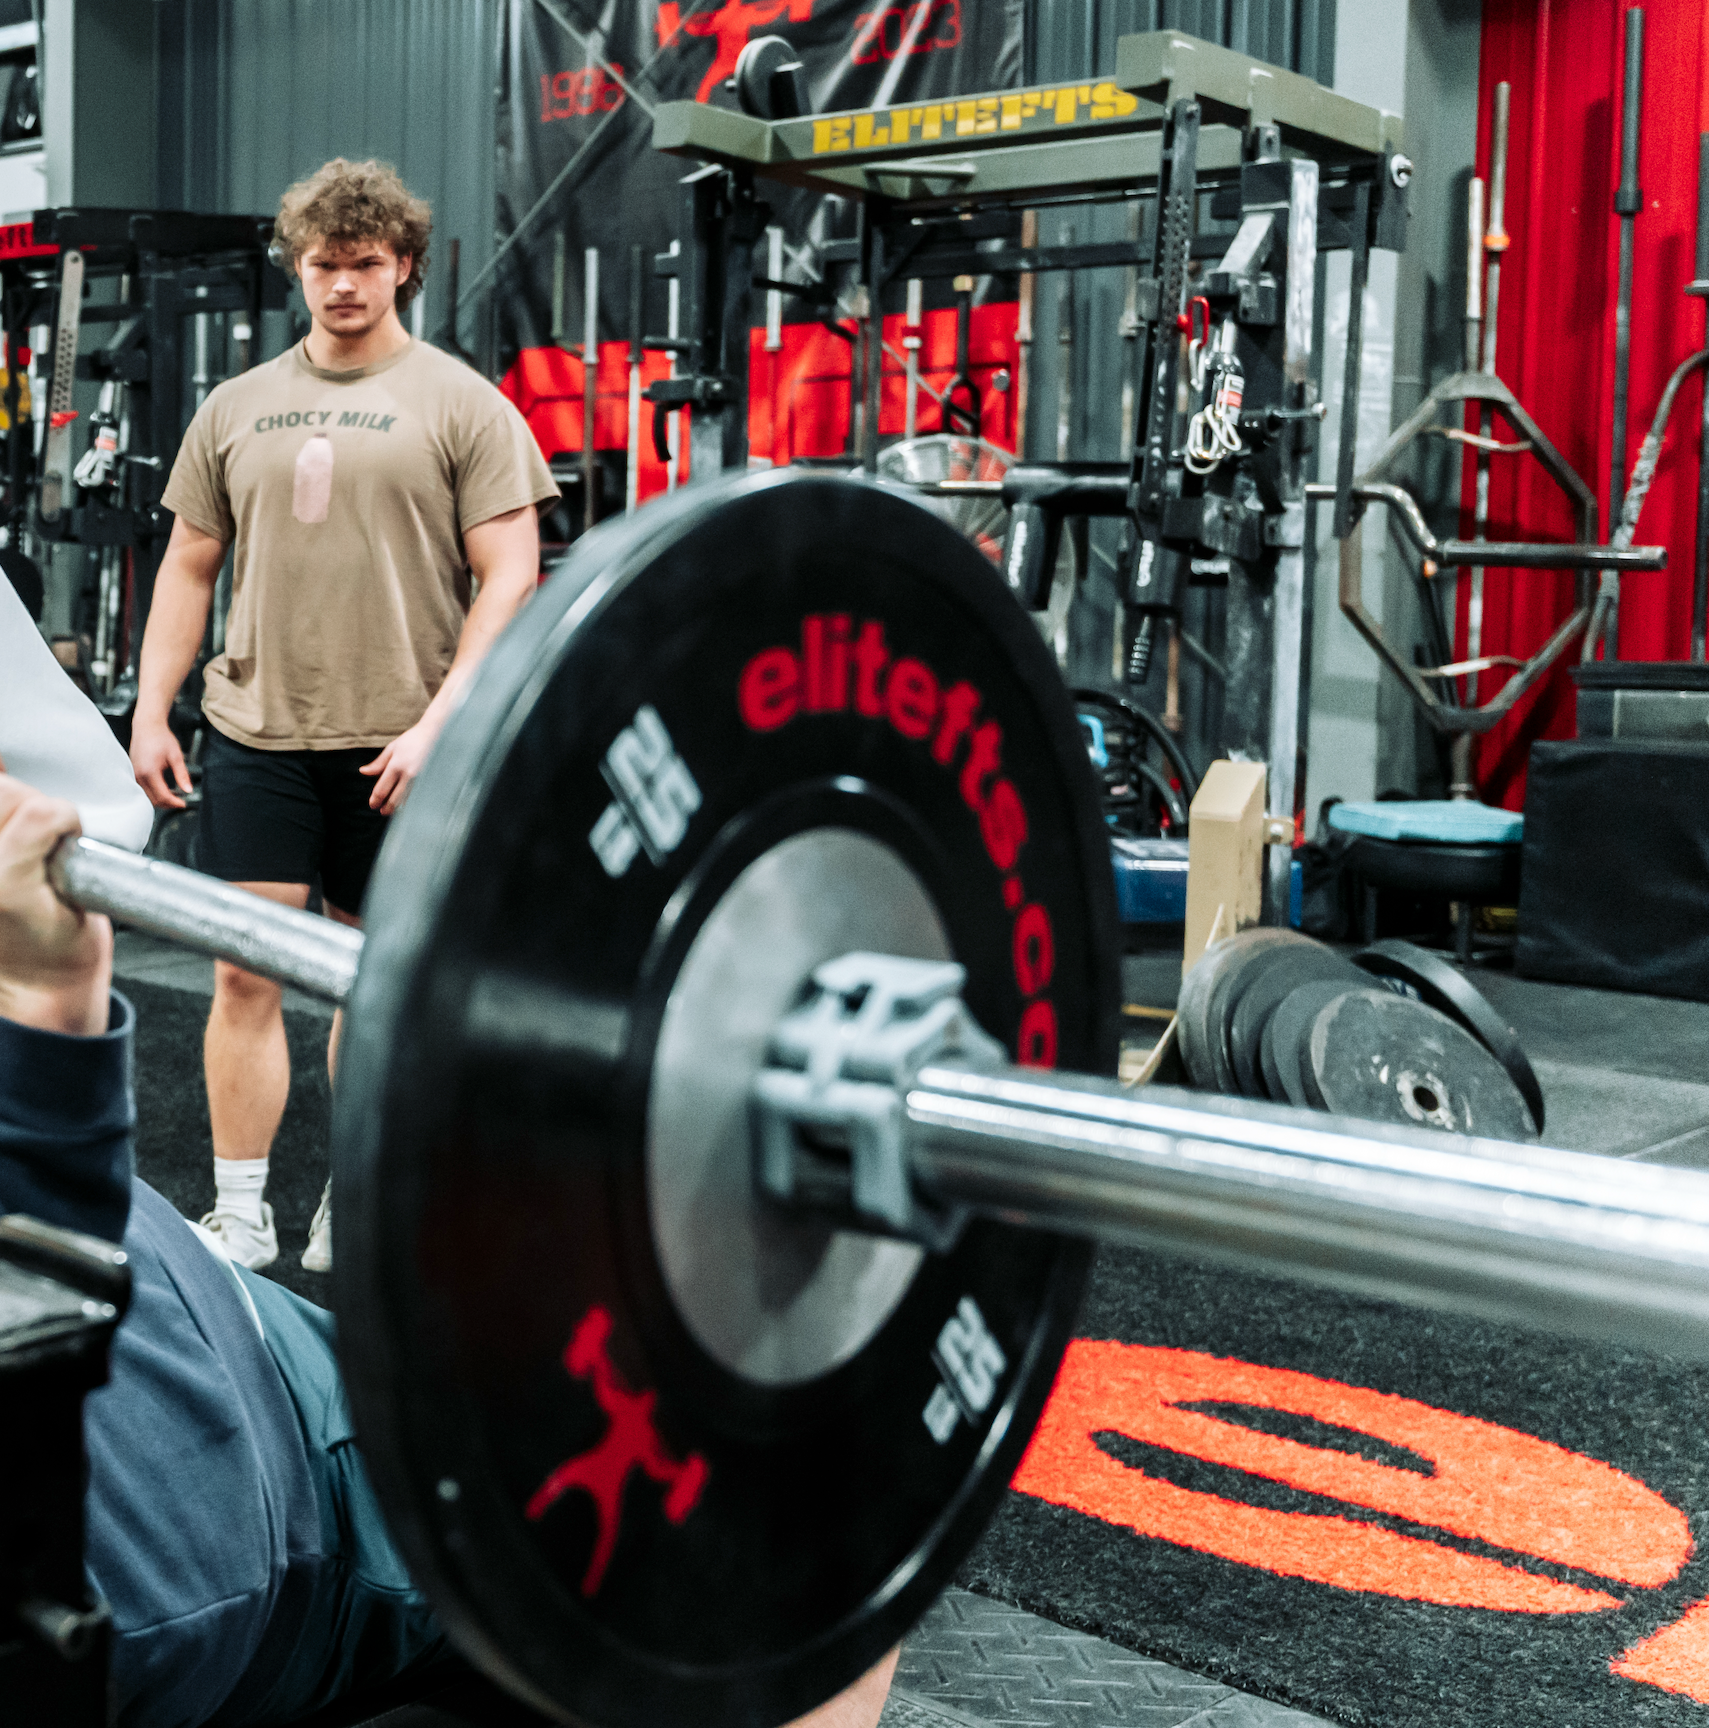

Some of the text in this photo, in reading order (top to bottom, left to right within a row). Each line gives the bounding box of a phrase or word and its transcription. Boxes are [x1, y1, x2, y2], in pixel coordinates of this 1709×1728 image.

[852, 0, 962, 65] 2023
[813, 82, 1138, 154] ELITEFTS
[254, 411, 397, 434] CHOCY MILK
[738, 612, 1058, 1072] elitefts.co
